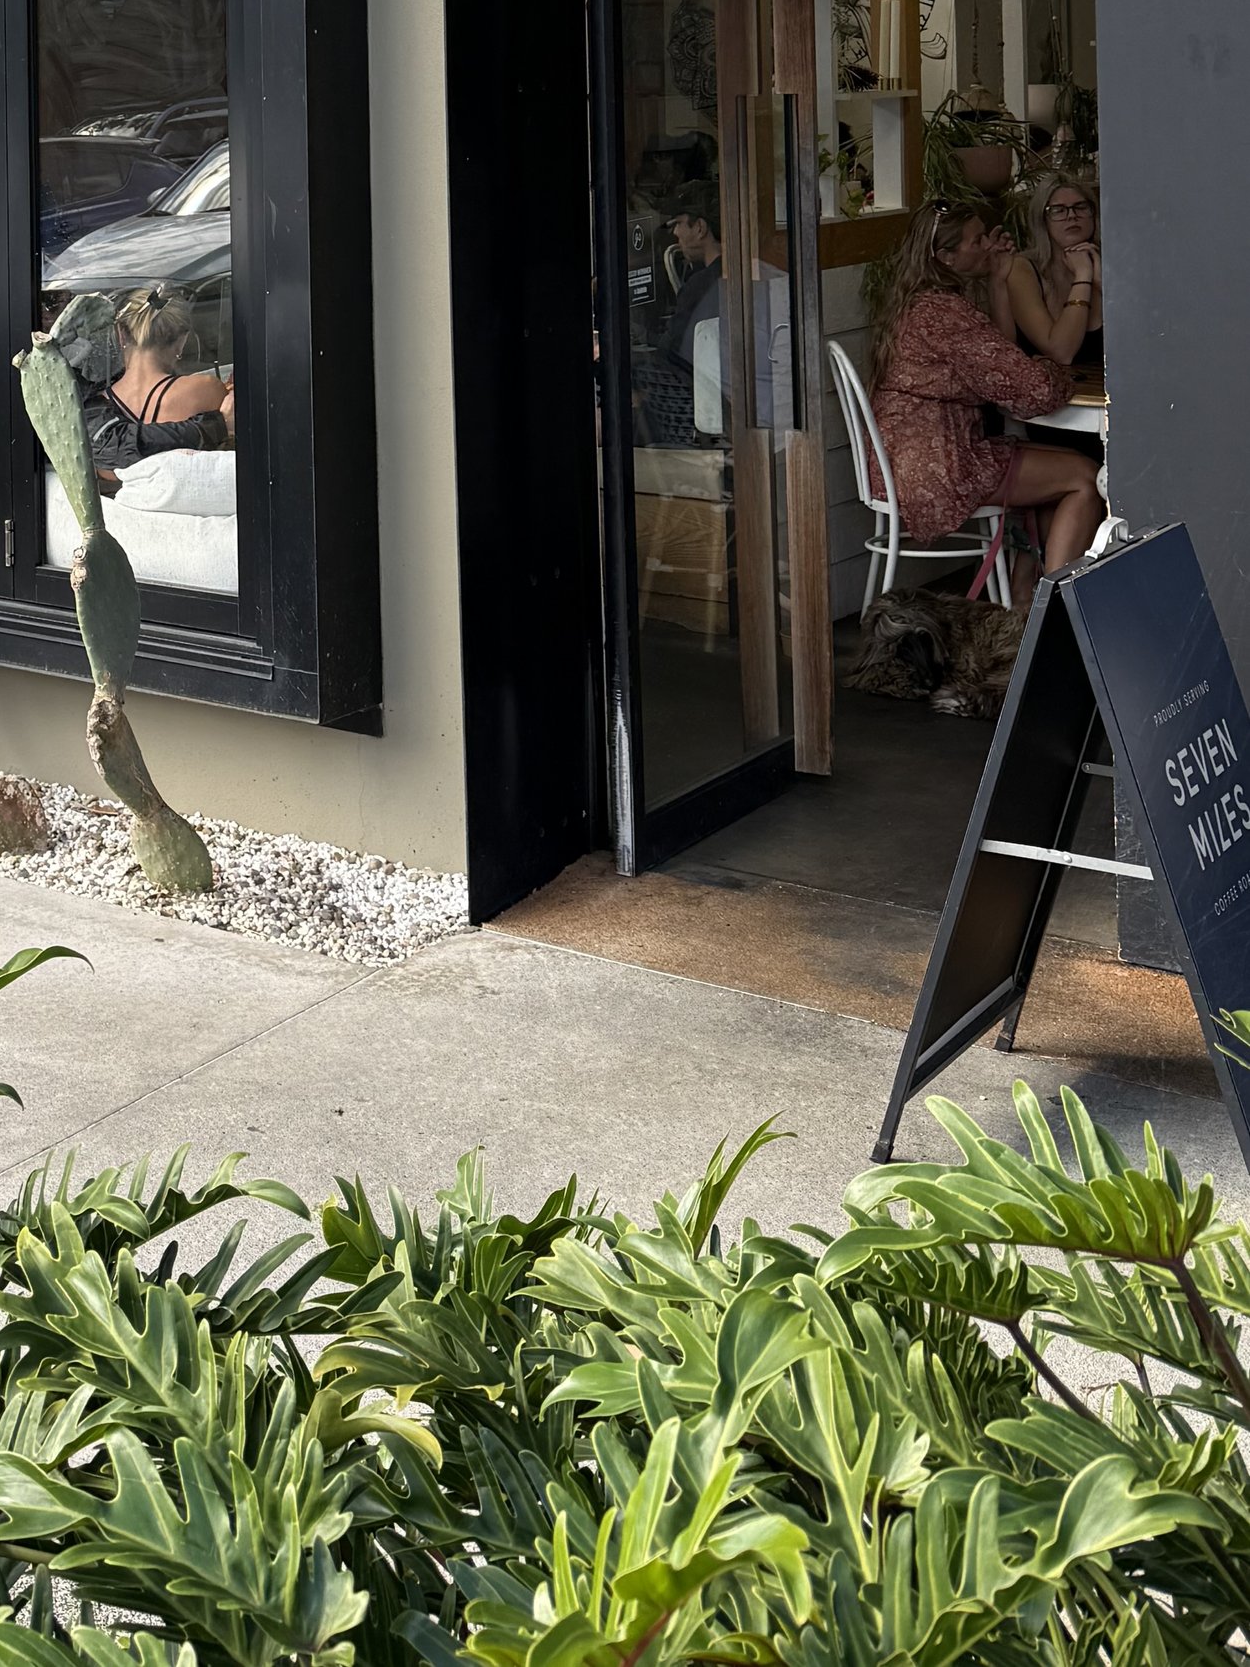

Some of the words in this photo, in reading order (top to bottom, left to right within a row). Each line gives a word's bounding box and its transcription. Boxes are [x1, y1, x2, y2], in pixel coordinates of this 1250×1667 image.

[1153, 696, 1183, 728] PROUDLY
[1183, 680, 1210, 708] SERVING
[1165, 718, 1238, 807] SEVEN
[1188, 784, 1250, 871] MILES
[1214, 885, 1239, 916] COFFEE
